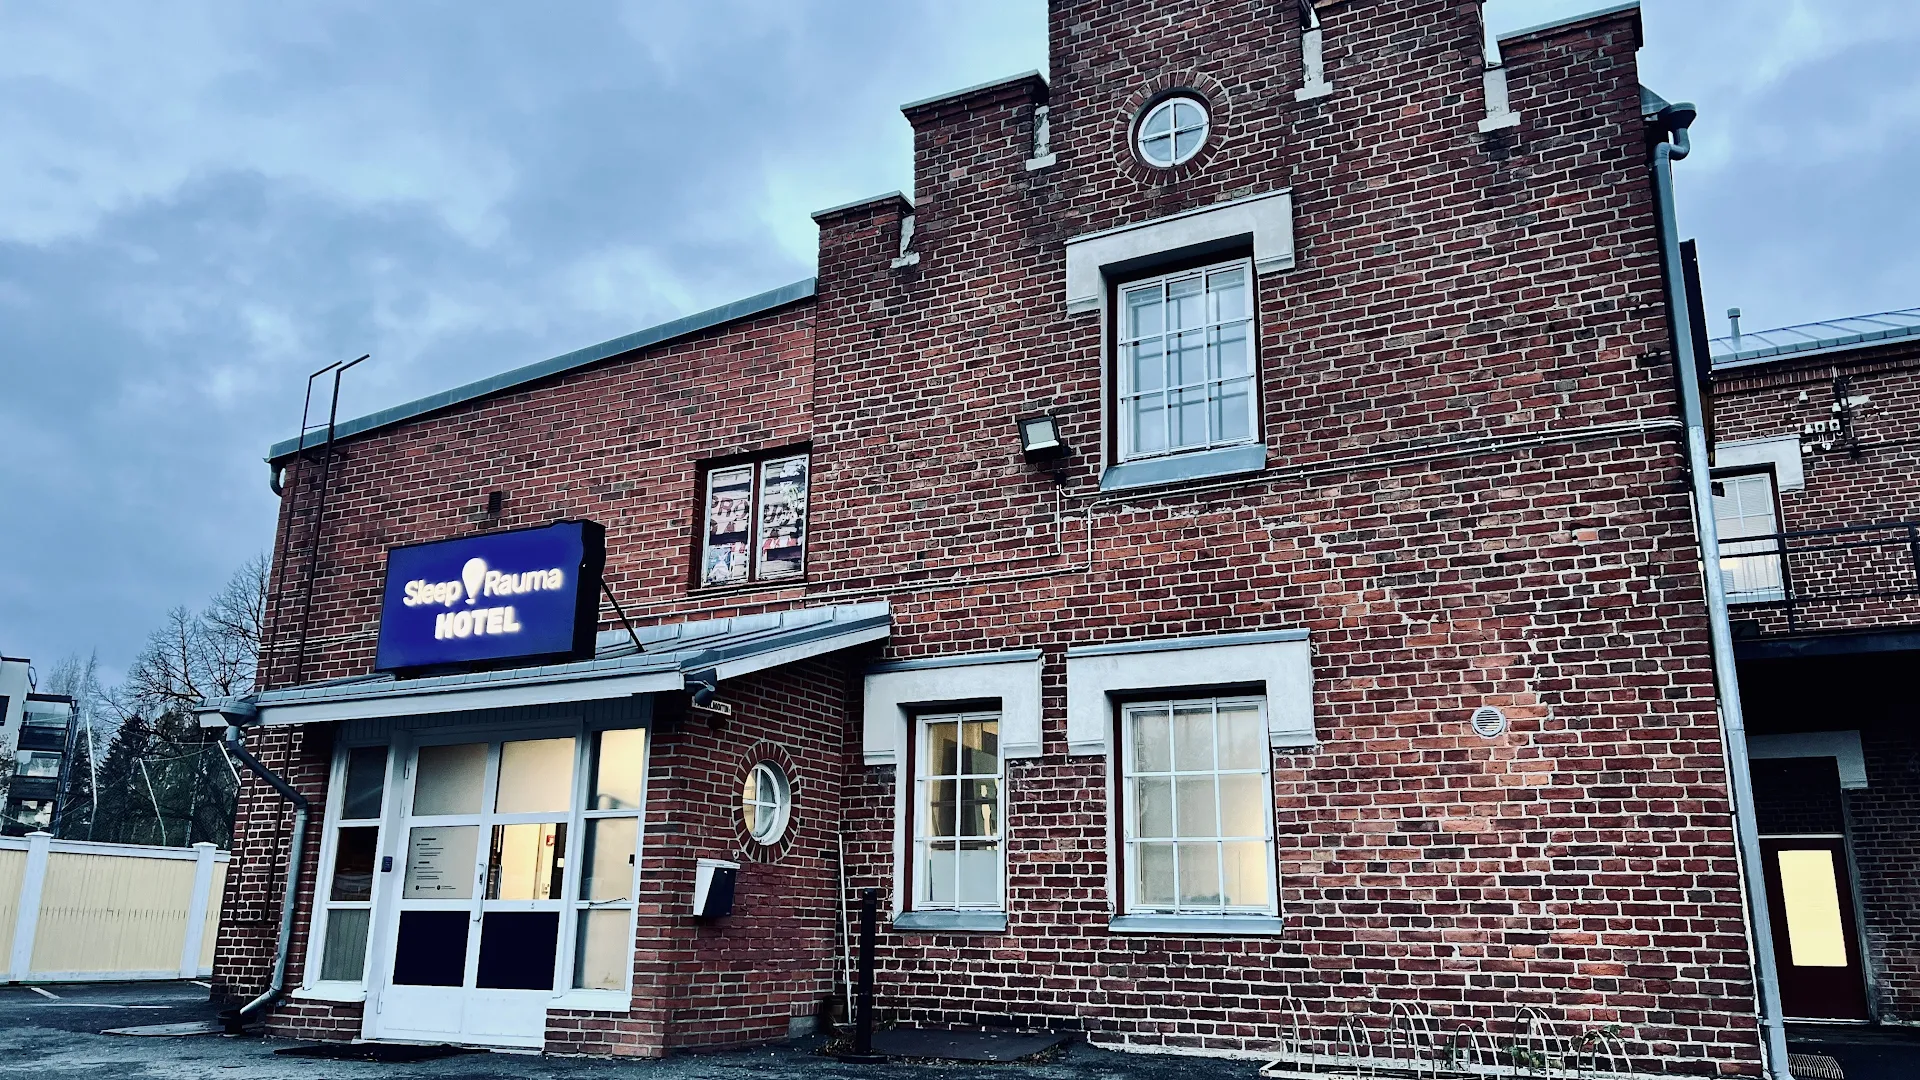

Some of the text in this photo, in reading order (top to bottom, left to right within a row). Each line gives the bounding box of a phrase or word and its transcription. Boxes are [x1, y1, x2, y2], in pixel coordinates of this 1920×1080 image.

[403, 568, 563, 607] Sleep Rauma
[434, 606, 521, 640] HOTEL
